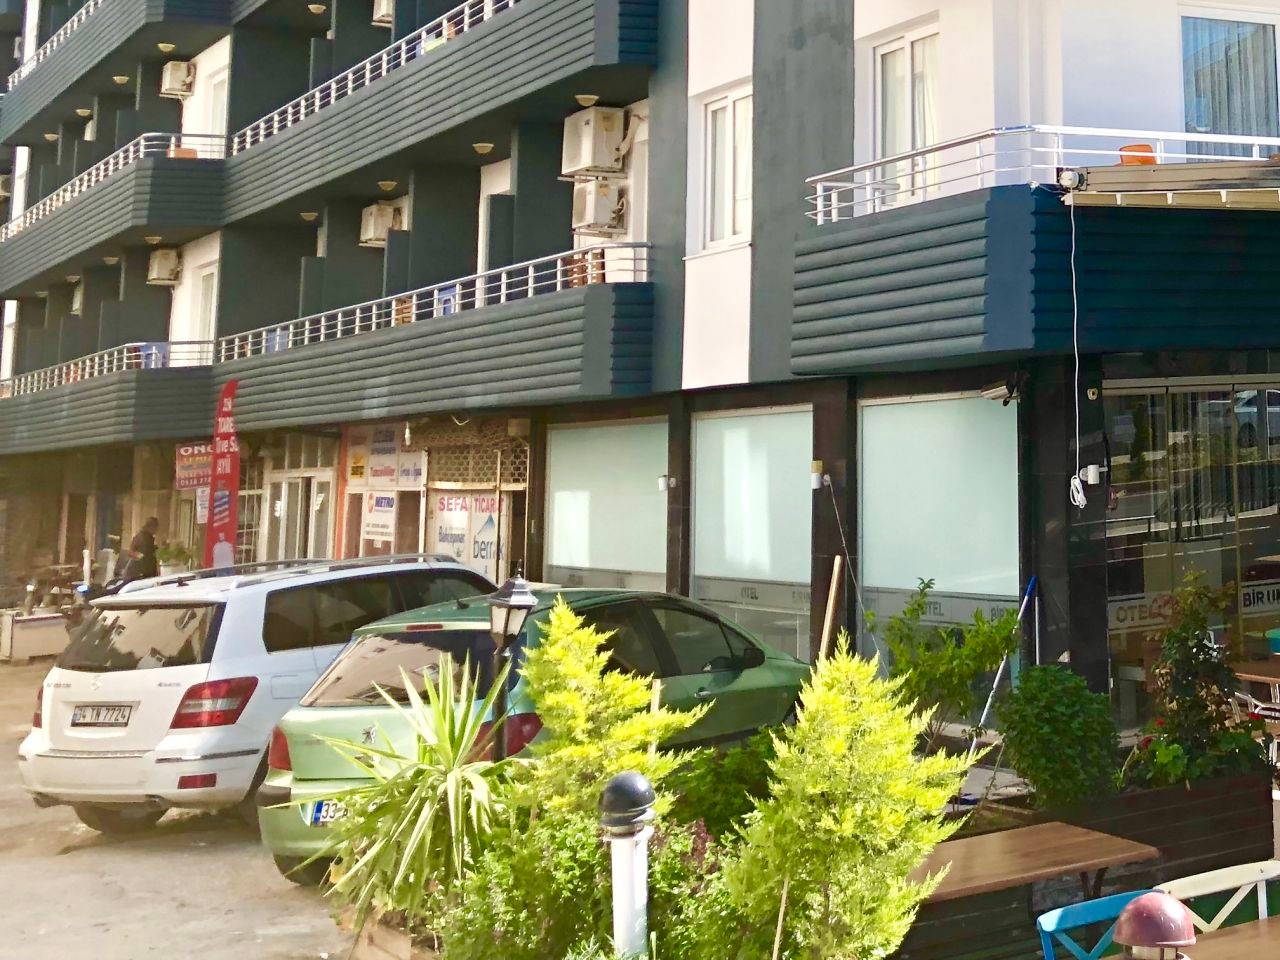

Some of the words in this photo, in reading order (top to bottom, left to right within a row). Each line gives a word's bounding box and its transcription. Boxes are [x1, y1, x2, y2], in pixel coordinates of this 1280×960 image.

[439, 496, 468, 512] SEFA
[474, 493, 504, 513] TİCART
[473, 535, 504, 560] berrk
[1243, 588, 1265, 608] BİR
[102, 707, 127, 722] 7724
[322, 803, 338, 819] 33
